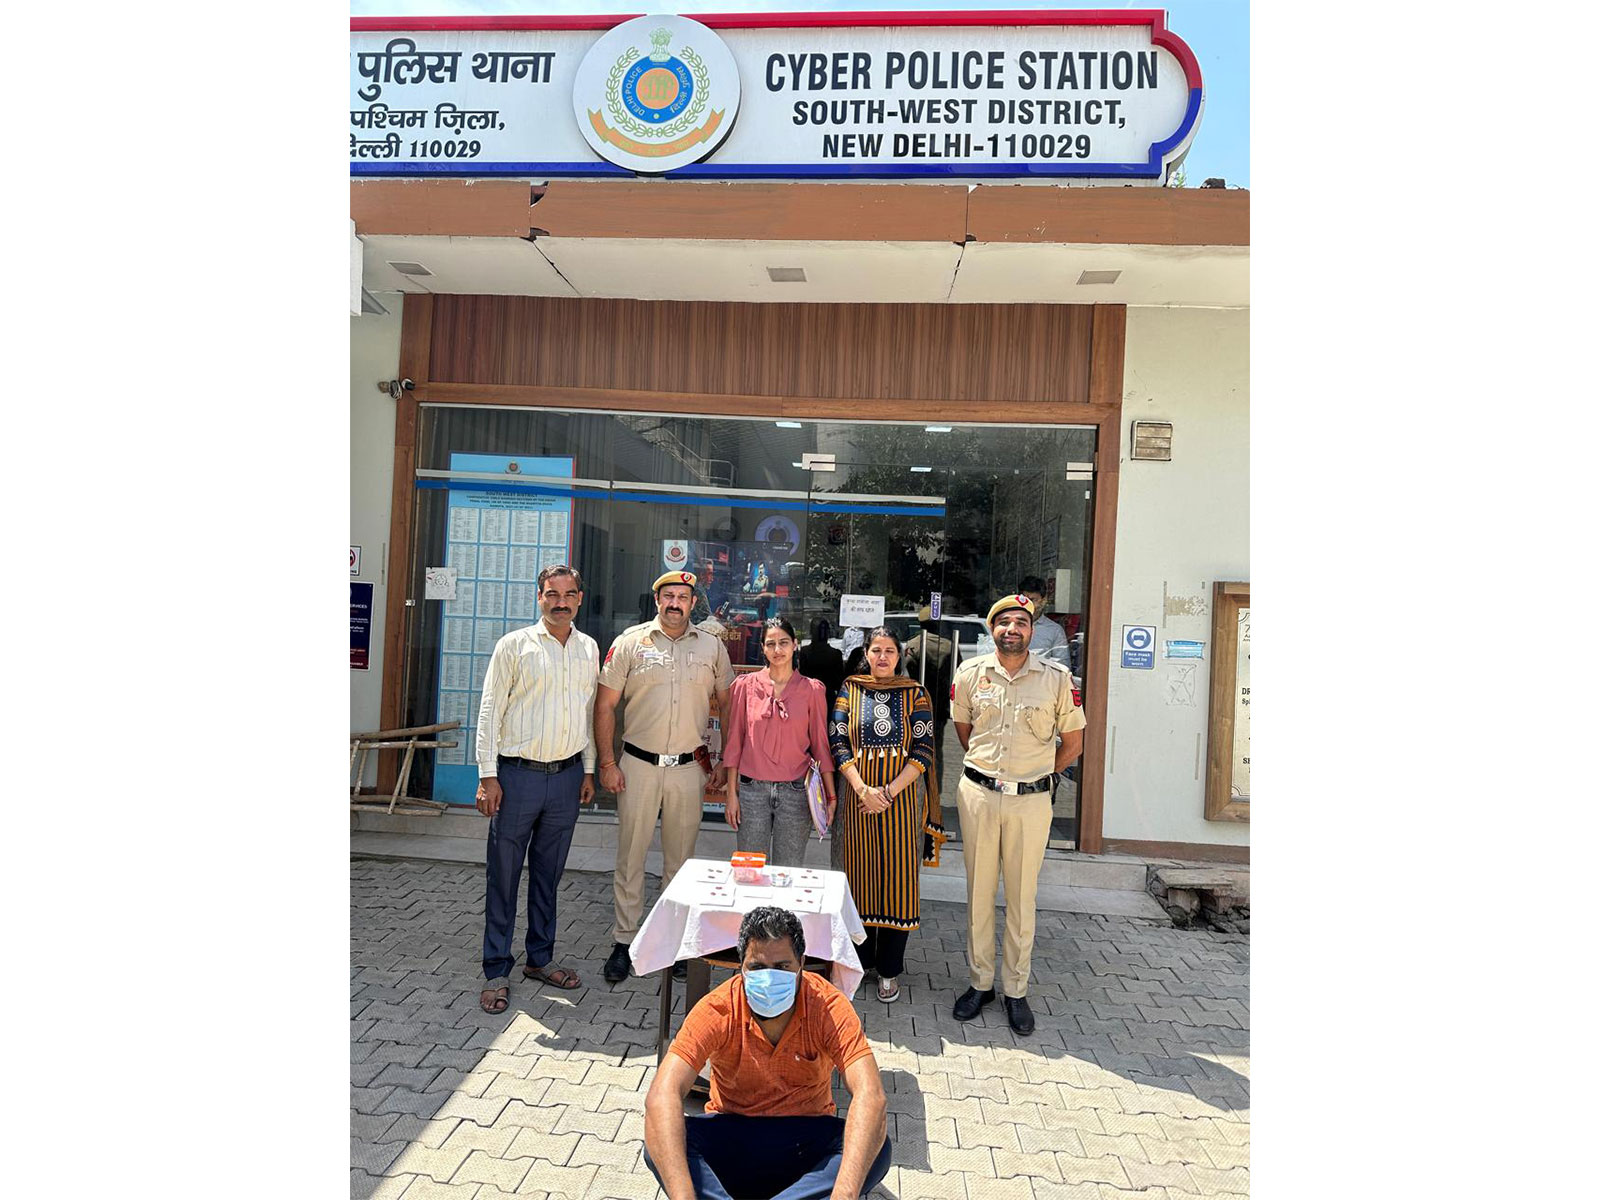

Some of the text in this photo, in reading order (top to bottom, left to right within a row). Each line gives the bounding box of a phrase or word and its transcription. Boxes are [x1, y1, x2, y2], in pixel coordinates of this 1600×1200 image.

[357, 38, 556, 102] पुलिस थाना
[624, 65, 643, 95] POLICE
[765, 50, 1159, 92] CYBER POLICE STATION
[792, 98, 1126, 129] SOUTH-WEST DISTRICT,
[410, 139, 481, 159] 110029
[822, 133, 1091, 159] NEW DELHI-110029
